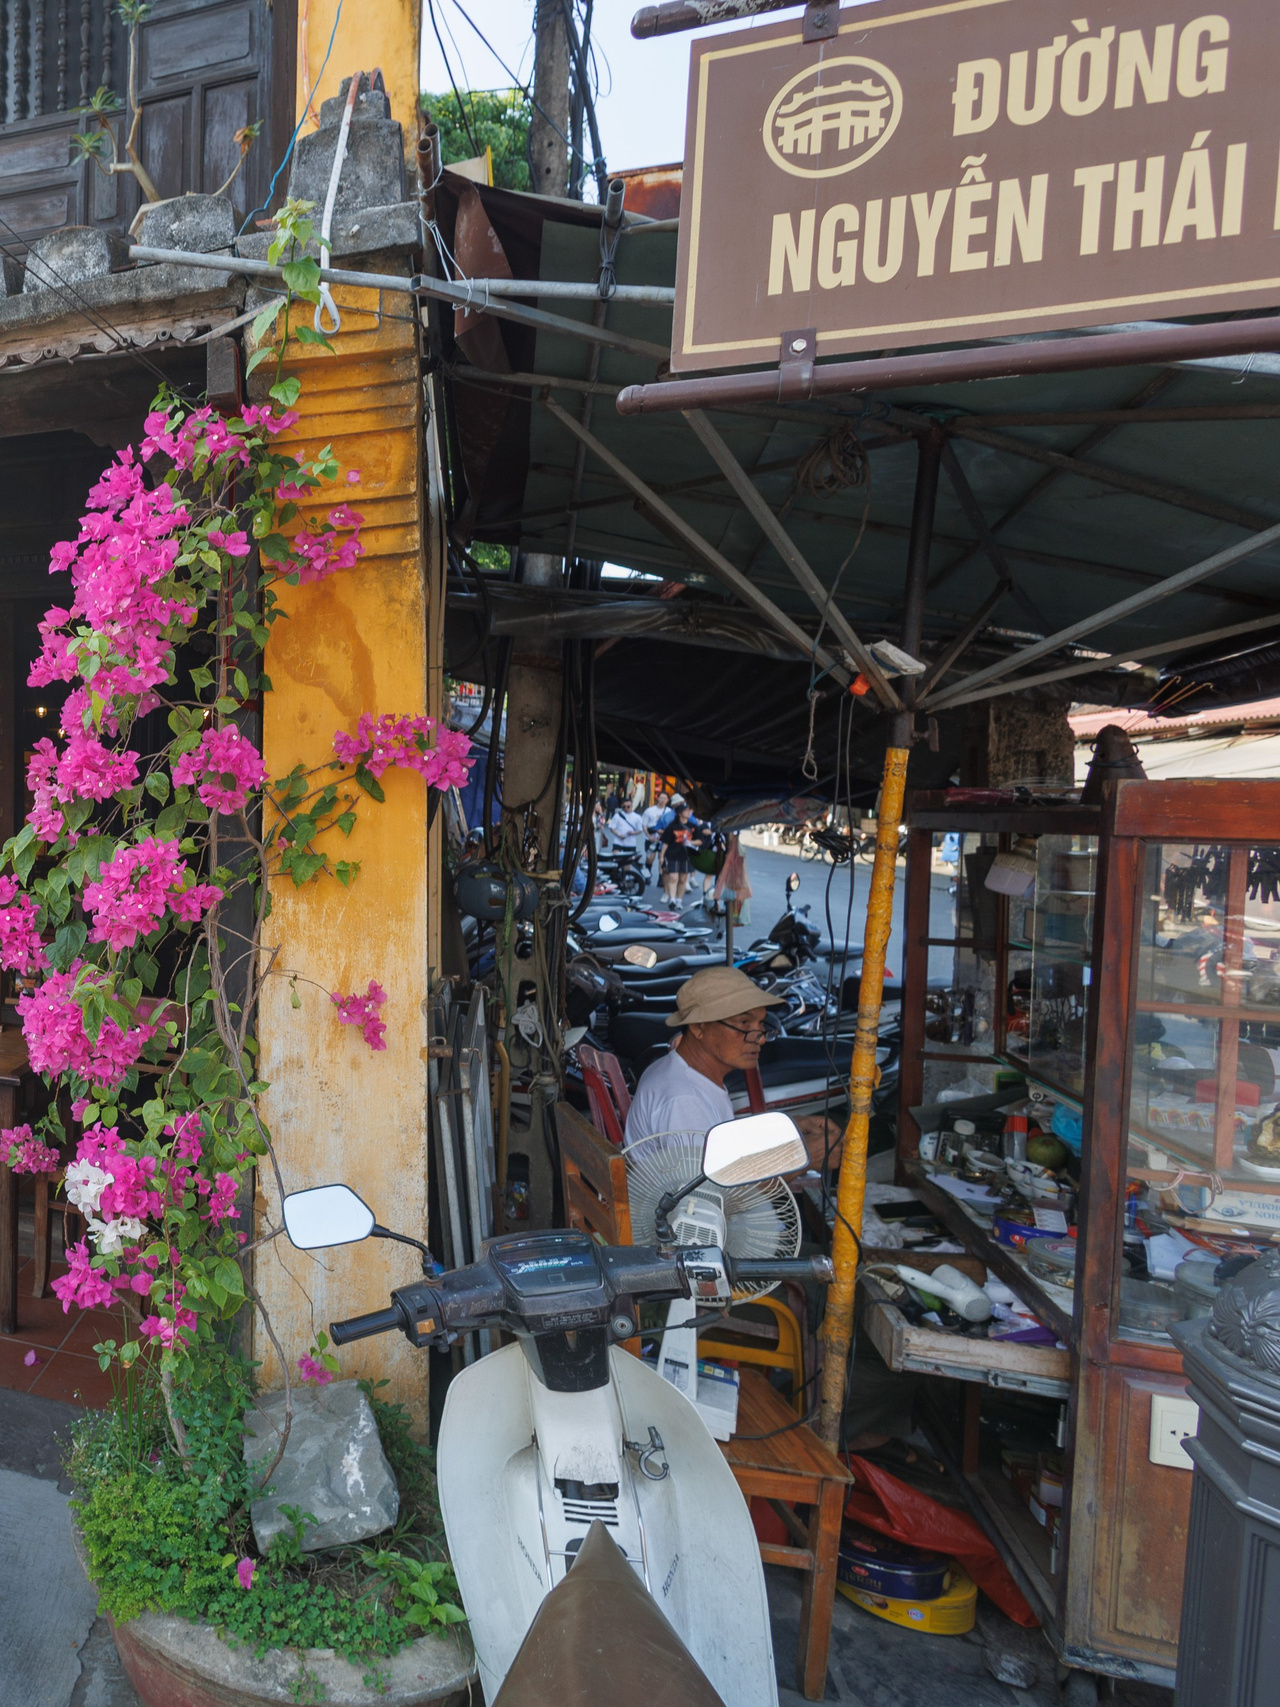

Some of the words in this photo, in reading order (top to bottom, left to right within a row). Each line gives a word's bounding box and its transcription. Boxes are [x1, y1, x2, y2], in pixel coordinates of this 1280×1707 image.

[952, 15, 1230, 136] ĐƯỜNG
[767, 153, 1049, 296] NGUYỄN
[1073, 130, 1248, 255] THÁI
[517, 1535, 544, 1589] HONDA
[661, 1553, 680, 1599] HONDA
